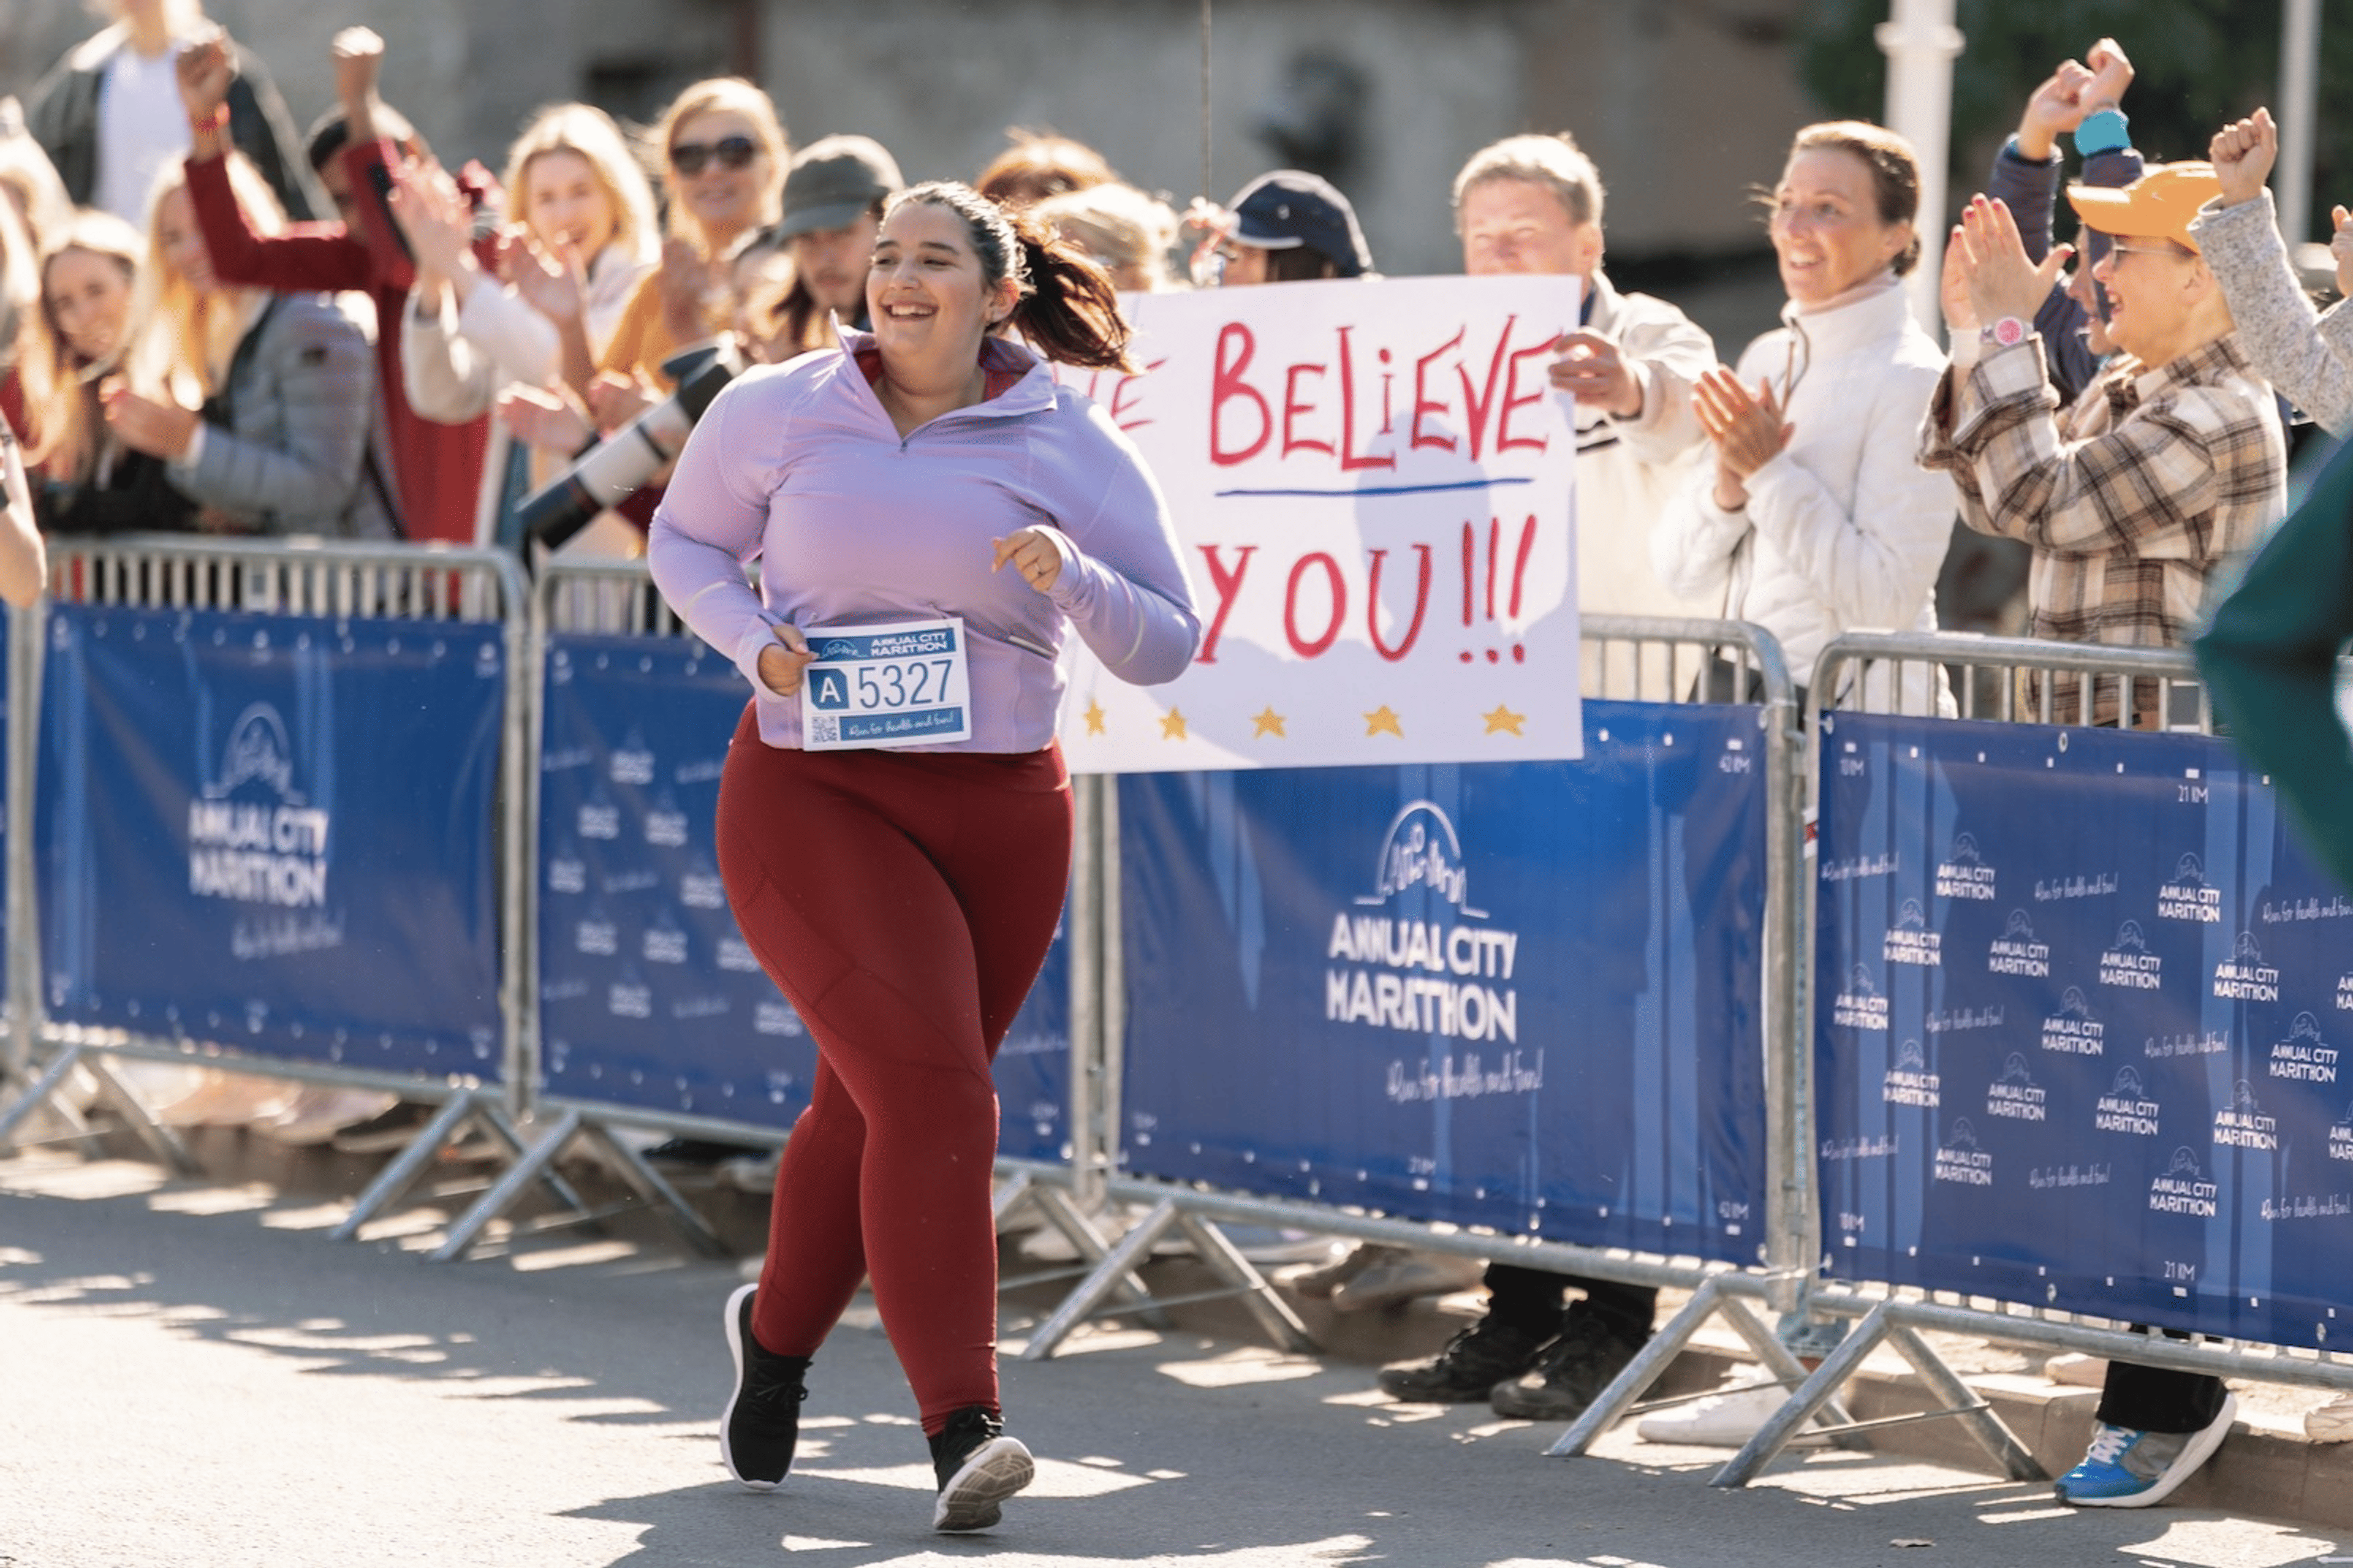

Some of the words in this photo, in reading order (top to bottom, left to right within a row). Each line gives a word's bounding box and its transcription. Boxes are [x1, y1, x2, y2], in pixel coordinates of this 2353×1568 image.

[819, 676, 841, 703] A
[858, 659, 952, 708] 5327
[1328, 912, 1445, 971] ANNUAL
[1447, 926, 1518, 980] CITY
[1326, 969, 1517, 1045] MARATHON
